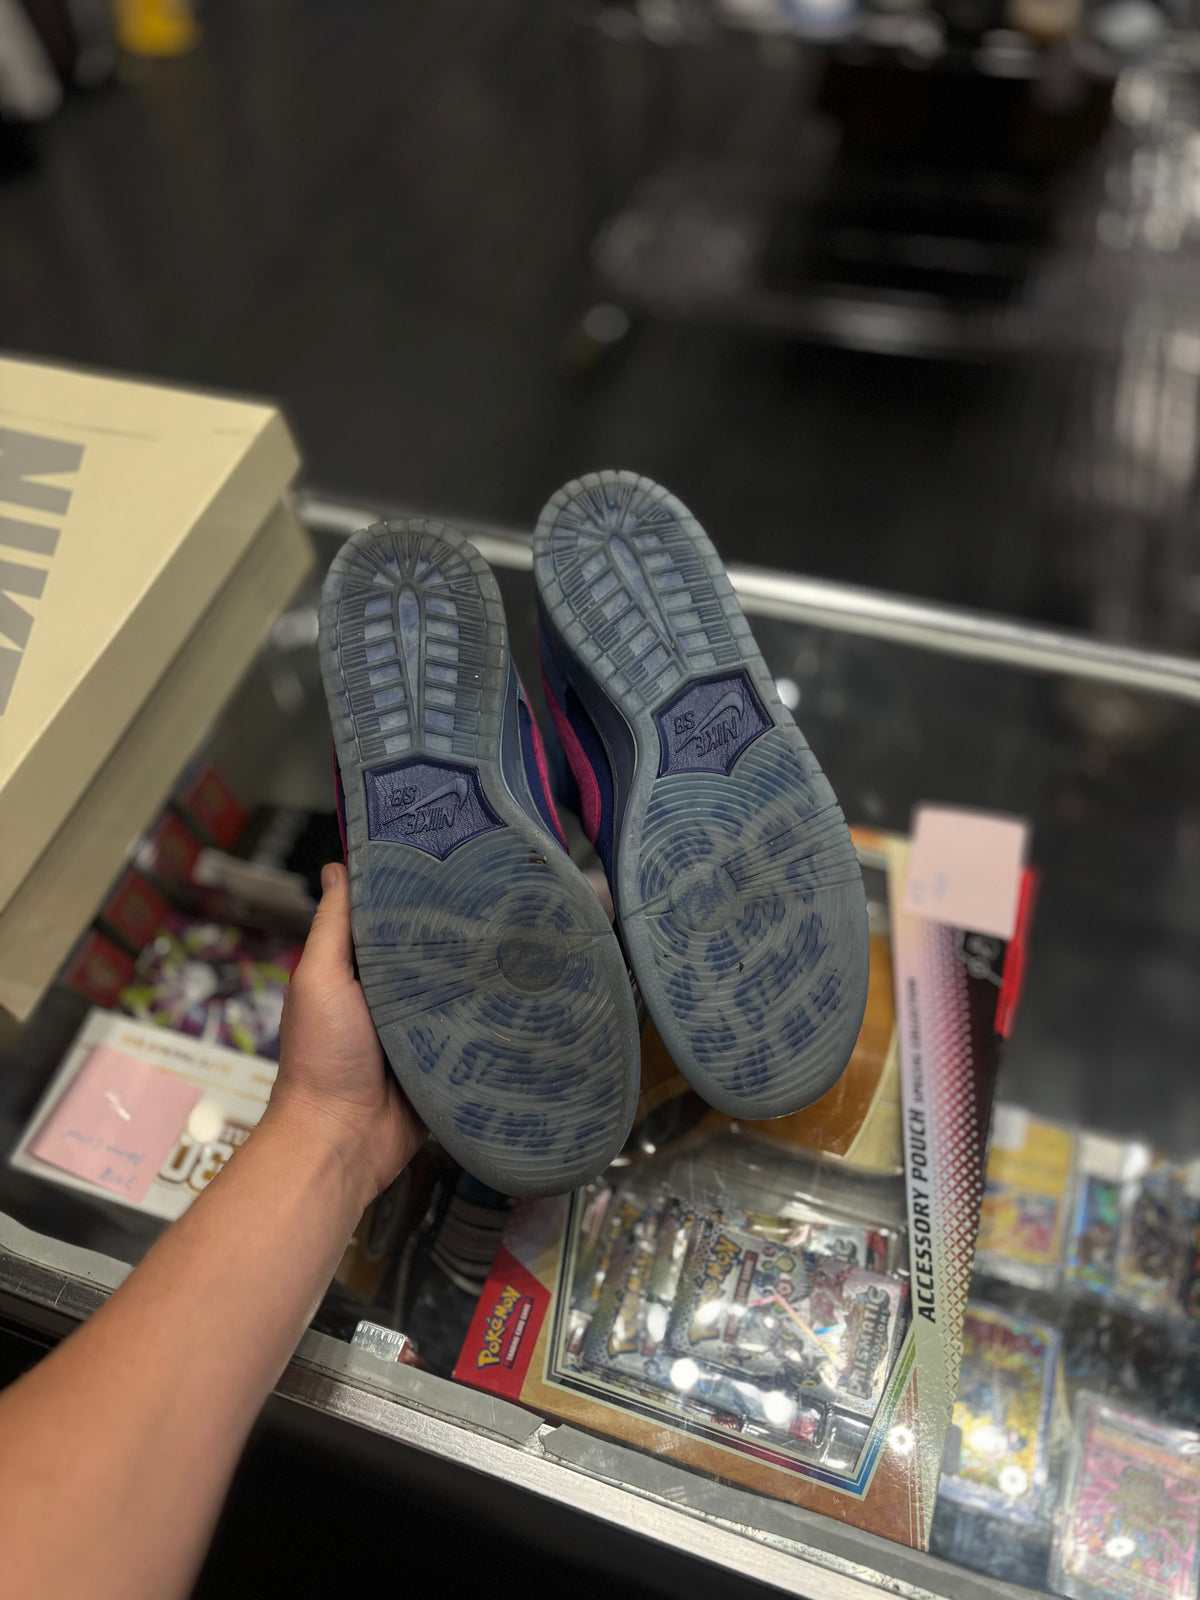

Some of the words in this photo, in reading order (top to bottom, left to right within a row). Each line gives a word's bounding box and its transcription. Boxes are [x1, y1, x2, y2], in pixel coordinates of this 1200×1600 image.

[674, 710, 695, 735] SB
[694, 716, 739, 757] NIKE
[391, 785, 417, 806] SB
[401, 806, 457, 836] NIKE
[909, 1109, 928, 1183] POUCH
[912, 1189, 936, 1324] ACCESSORY
[506, 1336, 520, 1361] TRADING
[514, 1320, 526, 1336] CARD
[849, 1286, 889, 1397] PRISMATIC
